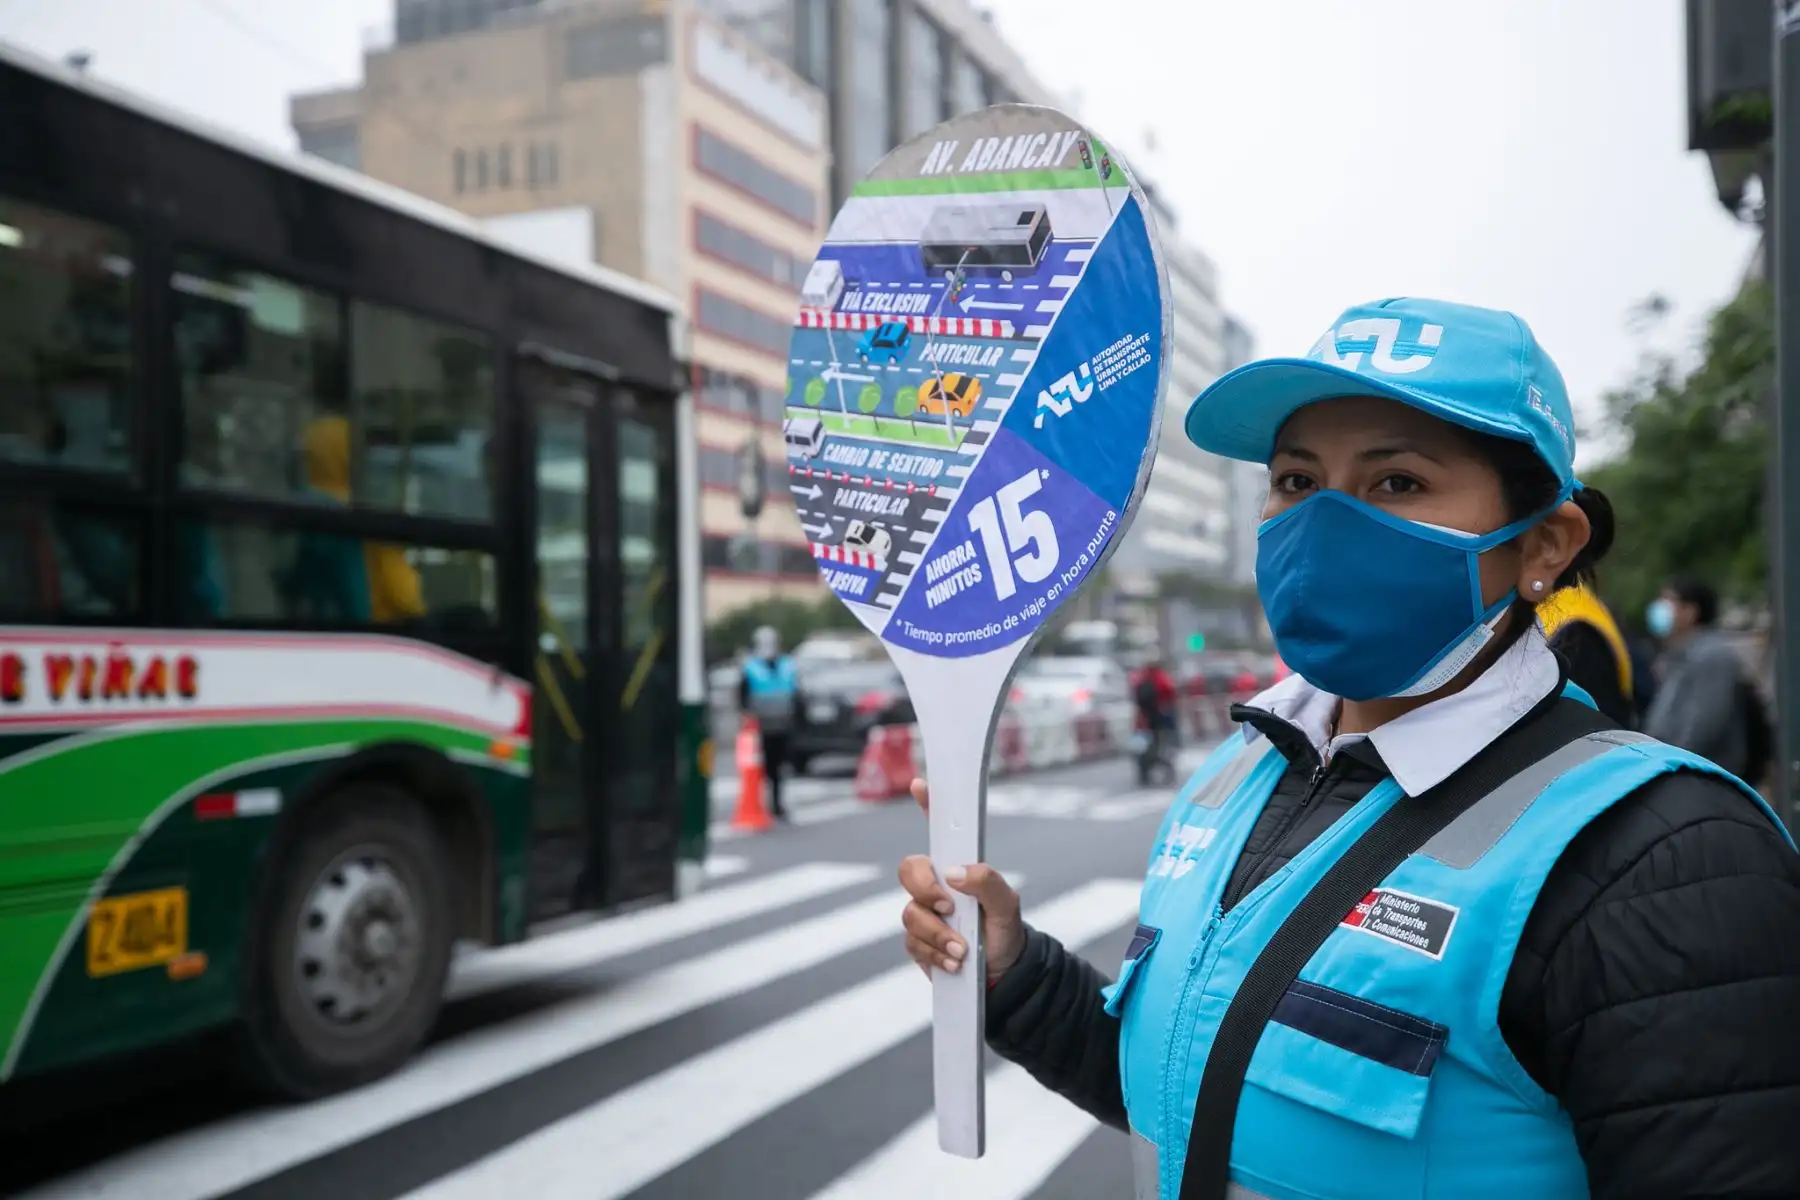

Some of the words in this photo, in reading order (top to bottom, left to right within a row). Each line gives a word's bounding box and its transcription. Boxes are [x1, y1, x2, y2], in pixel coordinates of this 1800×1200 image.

[919, 140, 959, 175] AV.
[959, 130, 1081, 173] ABANCAY
[840, 287, 861, 312] VÍA
[861, 292, 931, 314] EXCLUSIVA
[918, 342, 1004, 366] PARTICULAR
[1092, 334, 1133, 365] AUTORIDAD
[1094, 363, 1104, 374] DE
[1103, 332, 1150, 367] TRANSPORTE
[1096, 359, 1127, 382] URBANO
[1126, 347, 1147, 363] PARA
[1099, 376, 1117, 391] LIMA
[1116, 371, 1122, 380] Y
[1122, 354, 1151, 376] CALLAO
[822, 443, 869, 467] CAMBIO
[867, 450, 886, 470] DE
[887, 453, 944, 478] SENTIDO
[833, 487, 910, 516] PARTICULAR
[904, 620, 943, 645] Tiempo
[944, 622, 1002, 647] promedio
[1003, 615, 1019, 630] de
[1019, 597, 1047, 621] viaje
[1047, 582, 1062, 601] en
[1061, 554, 1089, 586] hora
[1087, 510, 1117, 556] punta
[925, 540, 977, 585] AHORRA
[925, 563, 982, 609] MINUTOS
[1372, 904, 1382, 916] de
[1383, 907, 1428, 931] Transportes
[1379, 894, 1420, 914] Ministerio
[1371, 919, 1430, 948] Comunicaciones
